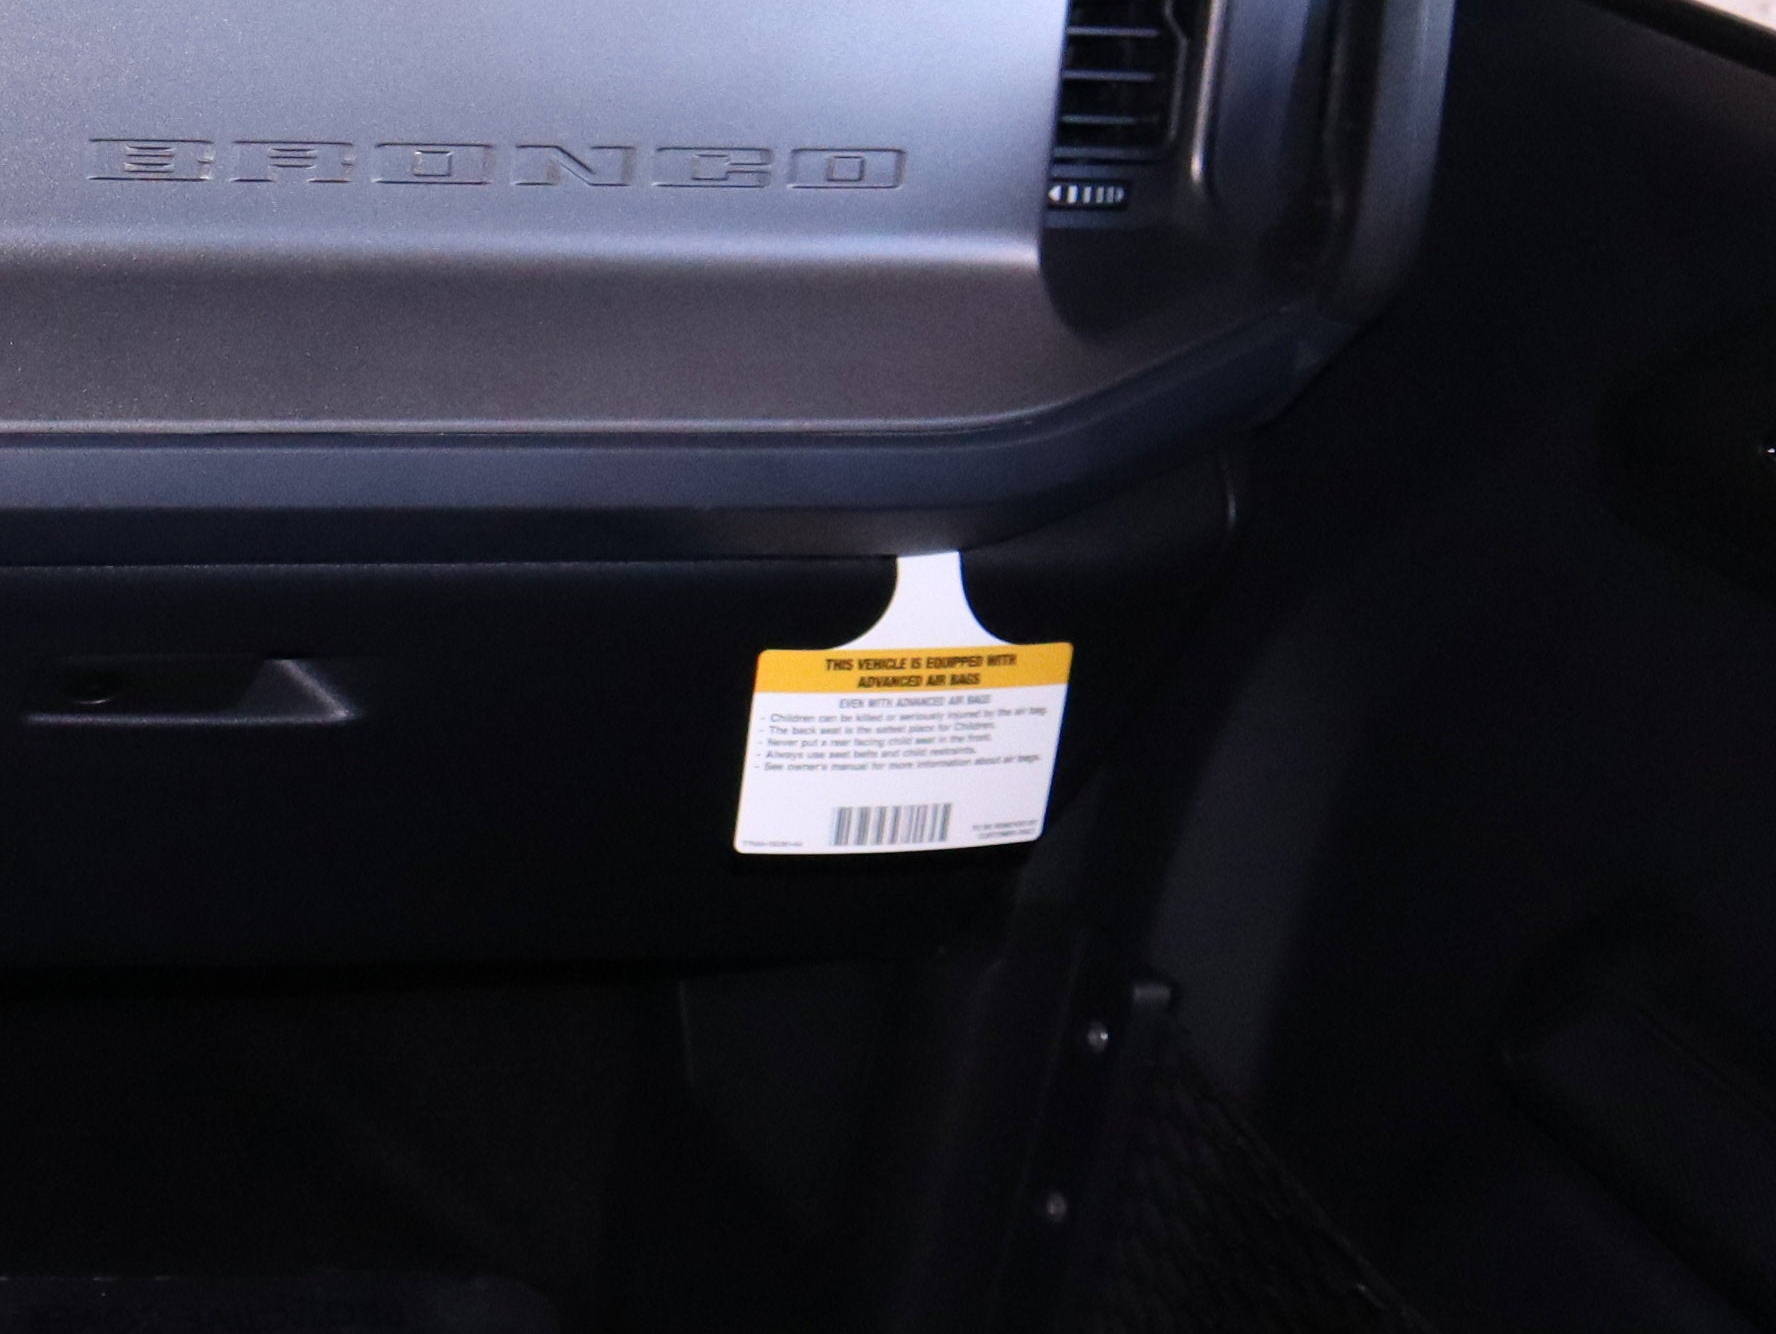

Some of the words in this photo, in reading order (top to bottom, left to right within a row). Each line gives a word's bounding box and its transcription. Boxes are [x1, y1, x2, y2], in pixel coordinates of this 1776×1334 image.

[88, 136, 907, 191] BRONCO
[826, 659, 854, 671] THIS
[858, 657, 907, 670] VEHICLE
[910, 657, 922, 669] IS
[926, 655, 983, 669] EQUIPPED
[986, 654, 1017, 667] WITH
[857, 675, 923, 688] ADVANCED
[926, 674, 946, 686] AIR
[950, 673, 980, 685] BAGS
